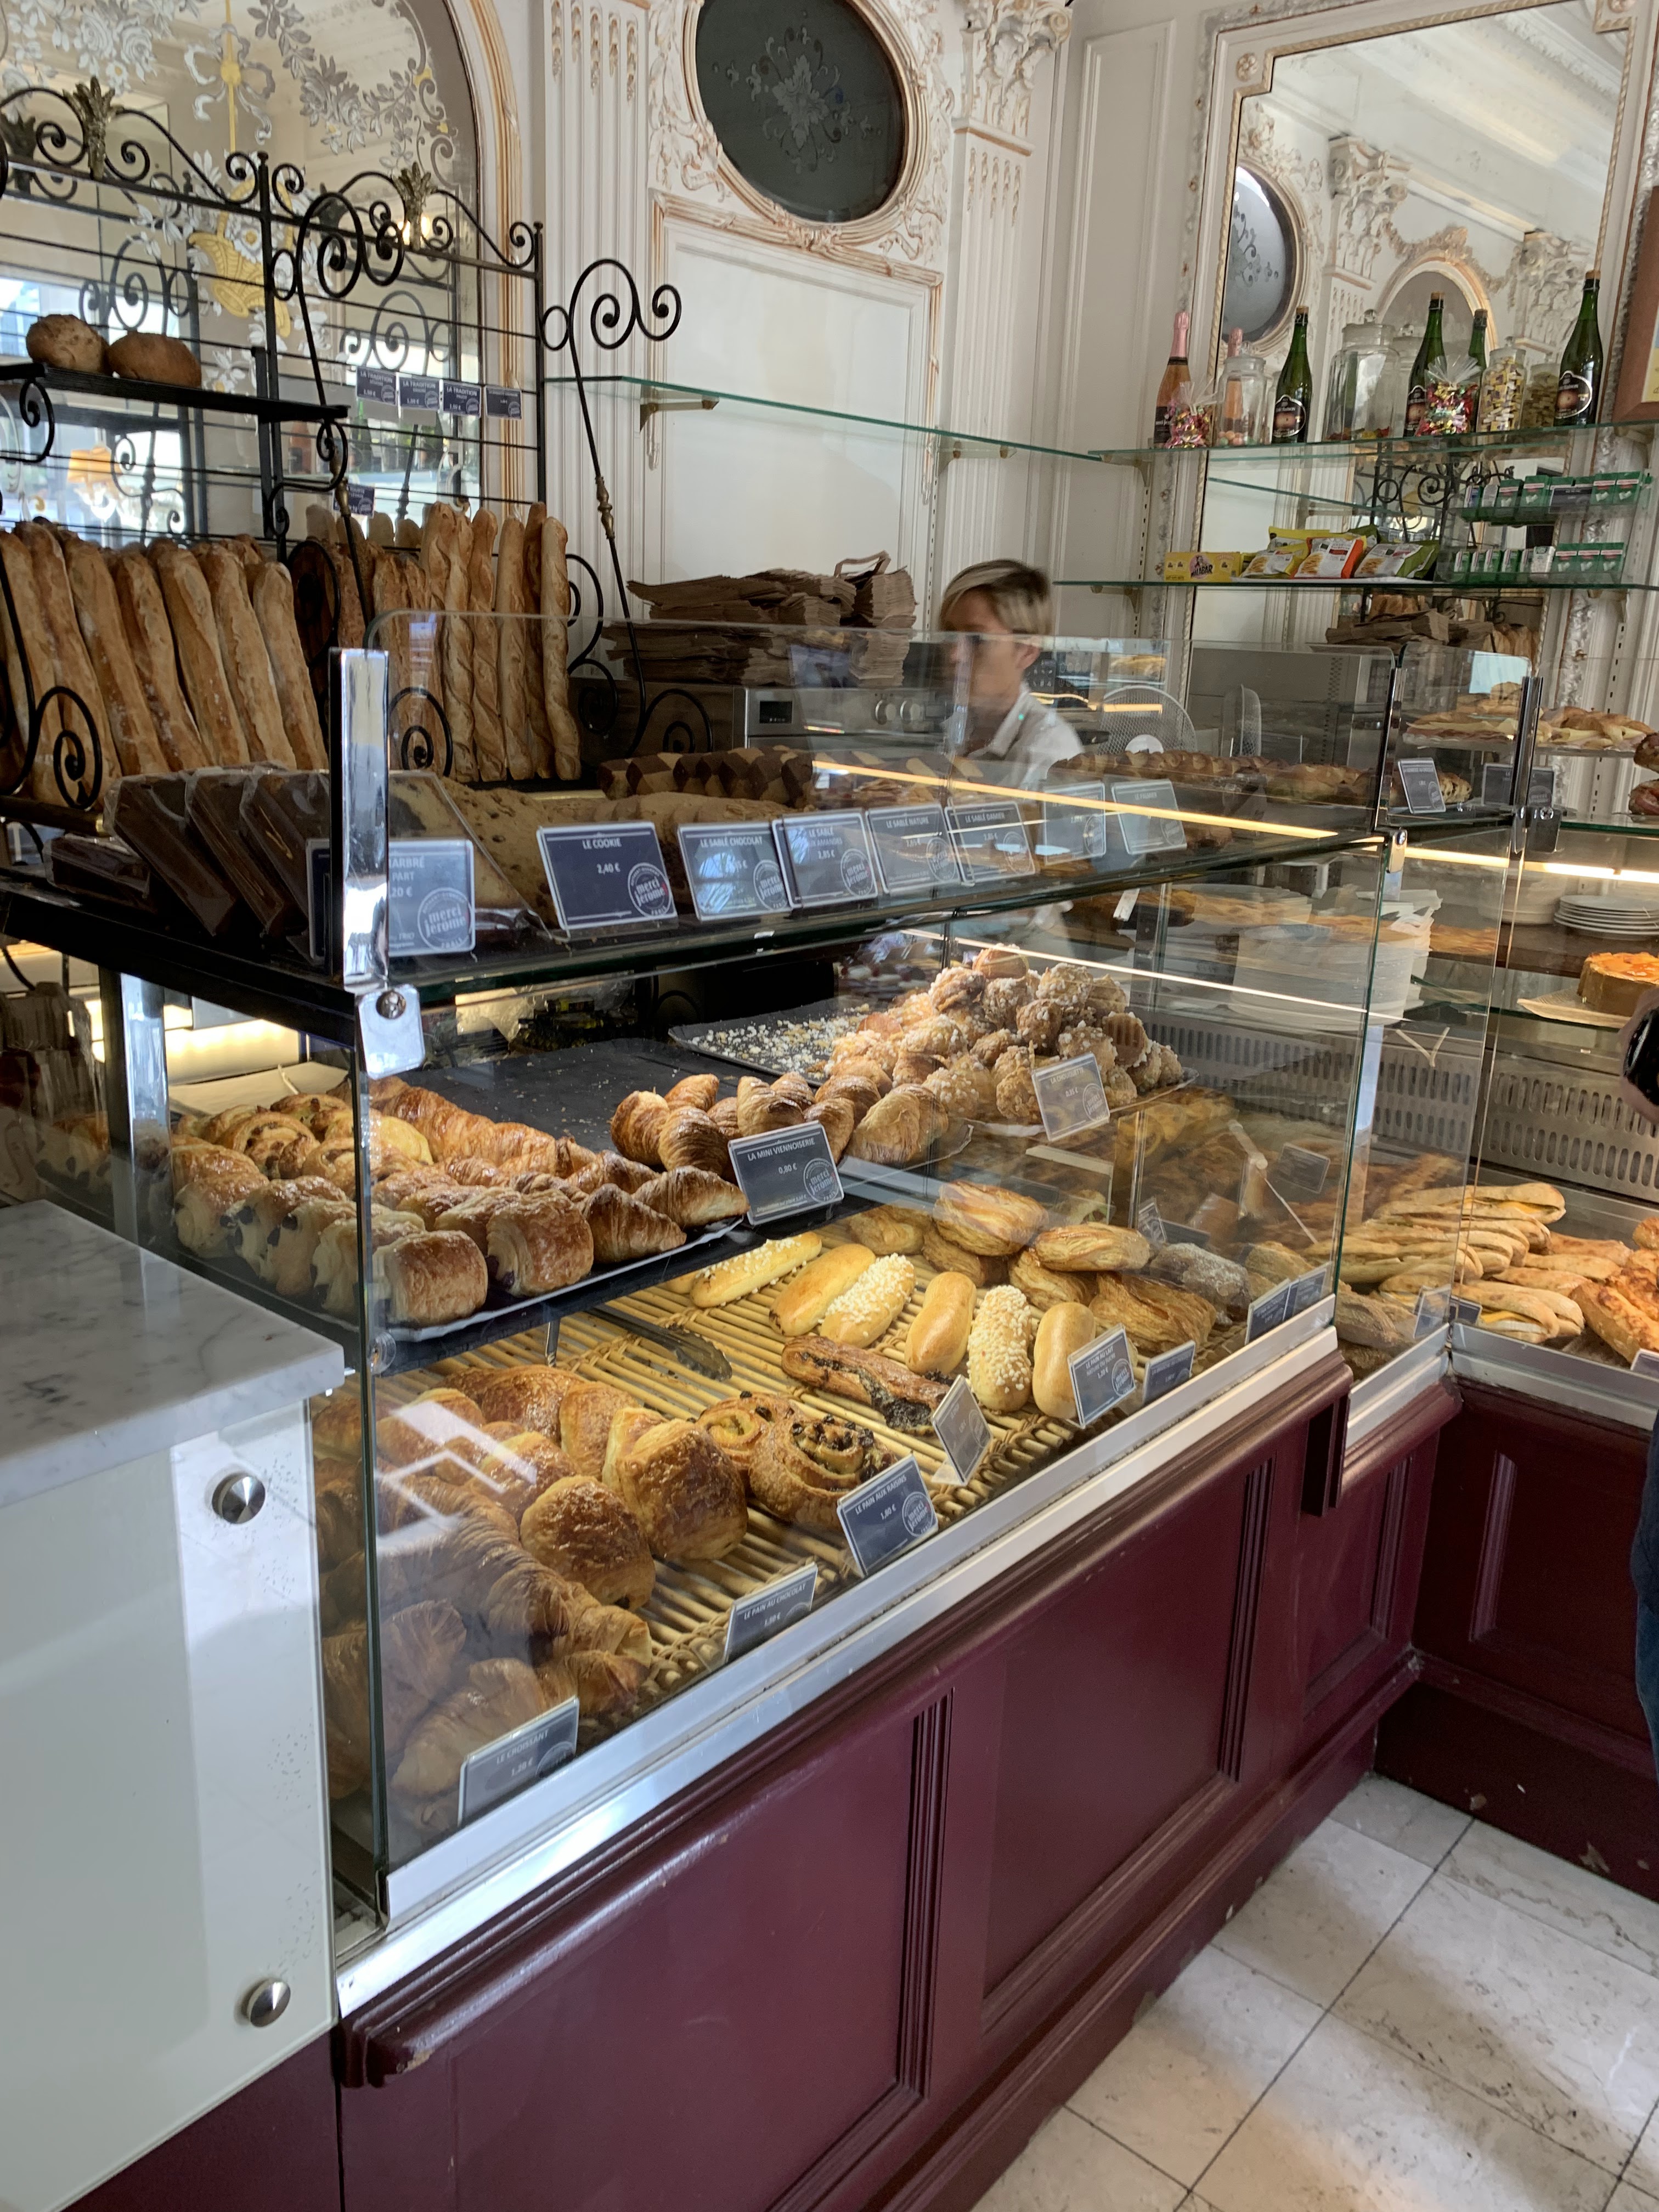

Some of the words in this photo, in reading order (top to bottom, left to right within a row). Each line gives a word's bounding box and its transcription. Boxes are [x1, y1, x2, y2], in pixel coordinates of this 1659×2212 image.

[886, 820, 893, 828] LE
[909, 816, 929, 826] NATURE
[971, 813, 986, 822] SABLÉ
[809, 829, 816, 837] LE
[816, 826, 833, 837] SABLÉ
[582, 839, 592, 850] LE
[592, 838, 622, 849] COOKIE
[699, 838, 708, 848] LE
[709, 837, 729, 848] SABLÉ
[729, 836, 763, 847] CHOCOLAT
[596, 863, 614, 876] 2,40
[614, 862, 621, 873] €
[392, 872, 414, 881] PART
[636, 876, 661, 895] merci
[405, 887, 413, 897] €
[747, 1152, 756, 1161] LA
[757, 1148, 773, 1159] MINI
[773, 1137, 815, 1155] VIENNOISERIE
[778, 1164, 792, 1175] 0,80
[792, 1163, 798, 1171] €
[810, 1168, 830, 1184] merci
[1090, 1356, 1099, 1366] PAIN
[855, 1506, 862, 1515] LE
[862, 1497, 876, 1512] PAIN
[876, 1488, 887, 1504] AUX
[886, 1475, 907, 1493] RAISINS
[891, 1503, 897, 1512] €
[744, 1611, 751, 1620] LE
[752, 1604, 766, 1616] PAIN
[767, 1599, 776, 1609] AU
[776, 1583, 806, 1604] CHOCOLAT
[496, 1754, 504, 1764] LE
[507, 1729, 549, 1758] CROISSANT
